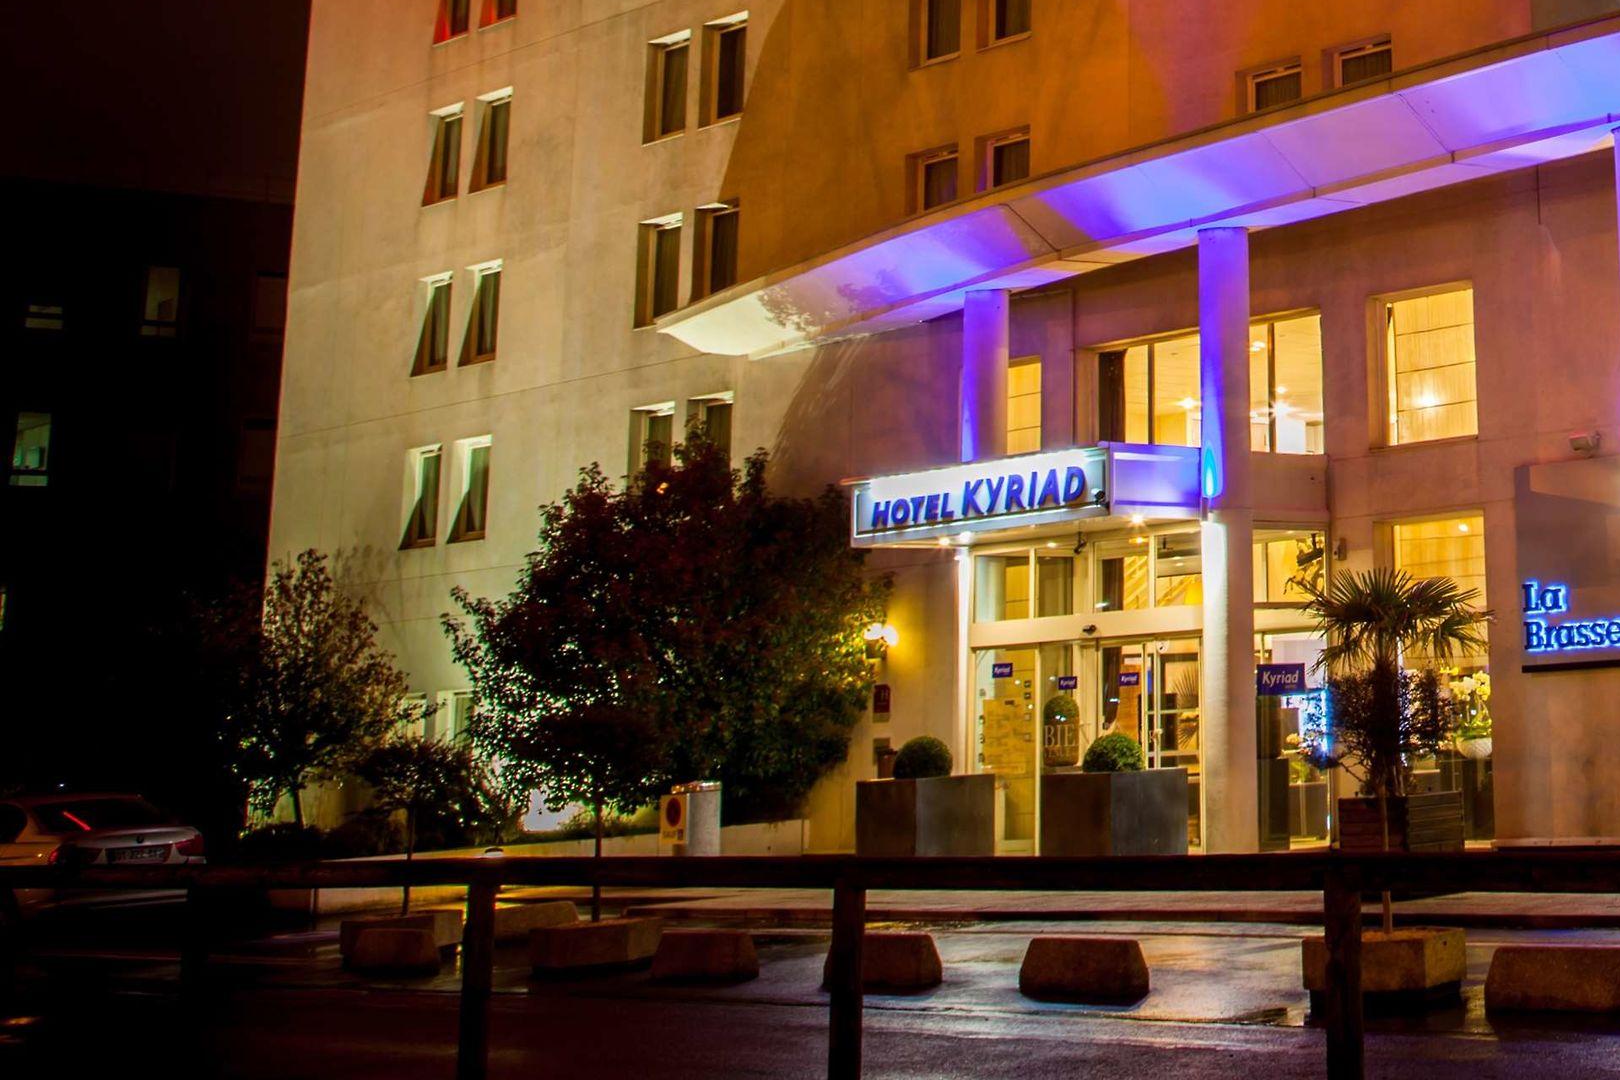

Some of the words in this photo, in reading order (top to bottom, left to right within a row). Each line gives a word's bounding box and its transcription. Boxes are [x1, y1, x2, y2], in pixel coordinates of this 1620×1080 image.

[871, 492, 954, 528] HOTEL
[961, 465, 1087, 517] KYRIAD
[1521, 582, 1563, 613] La
[1262, 669, 1299, 688] Kyriad
